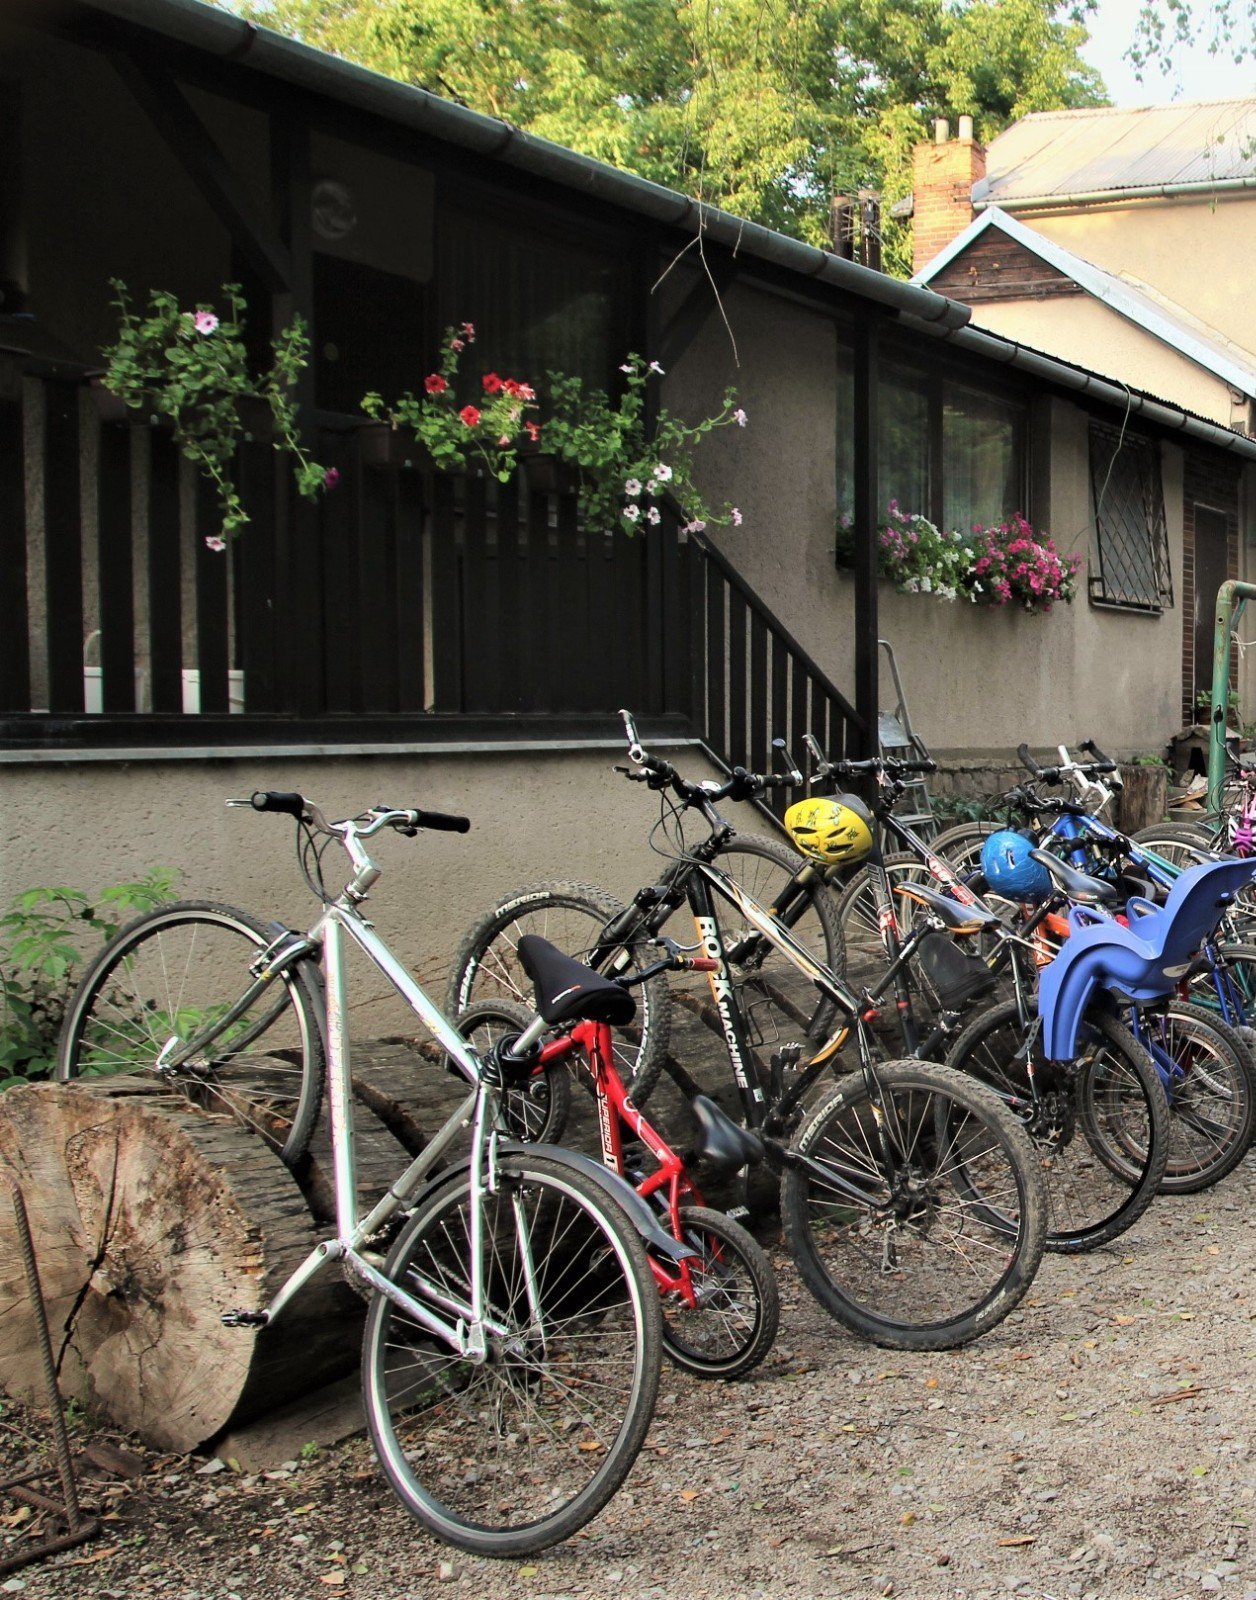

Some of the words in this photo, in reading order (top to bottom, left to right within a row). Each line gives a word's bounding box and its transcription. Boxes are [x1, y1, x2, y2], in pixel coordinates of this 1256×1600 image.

[495, 891, 550, 918] MERIDA
[717, 1001, 749, 1089] MACHINE
[799, 1093, 843, 1153] MERIDA
